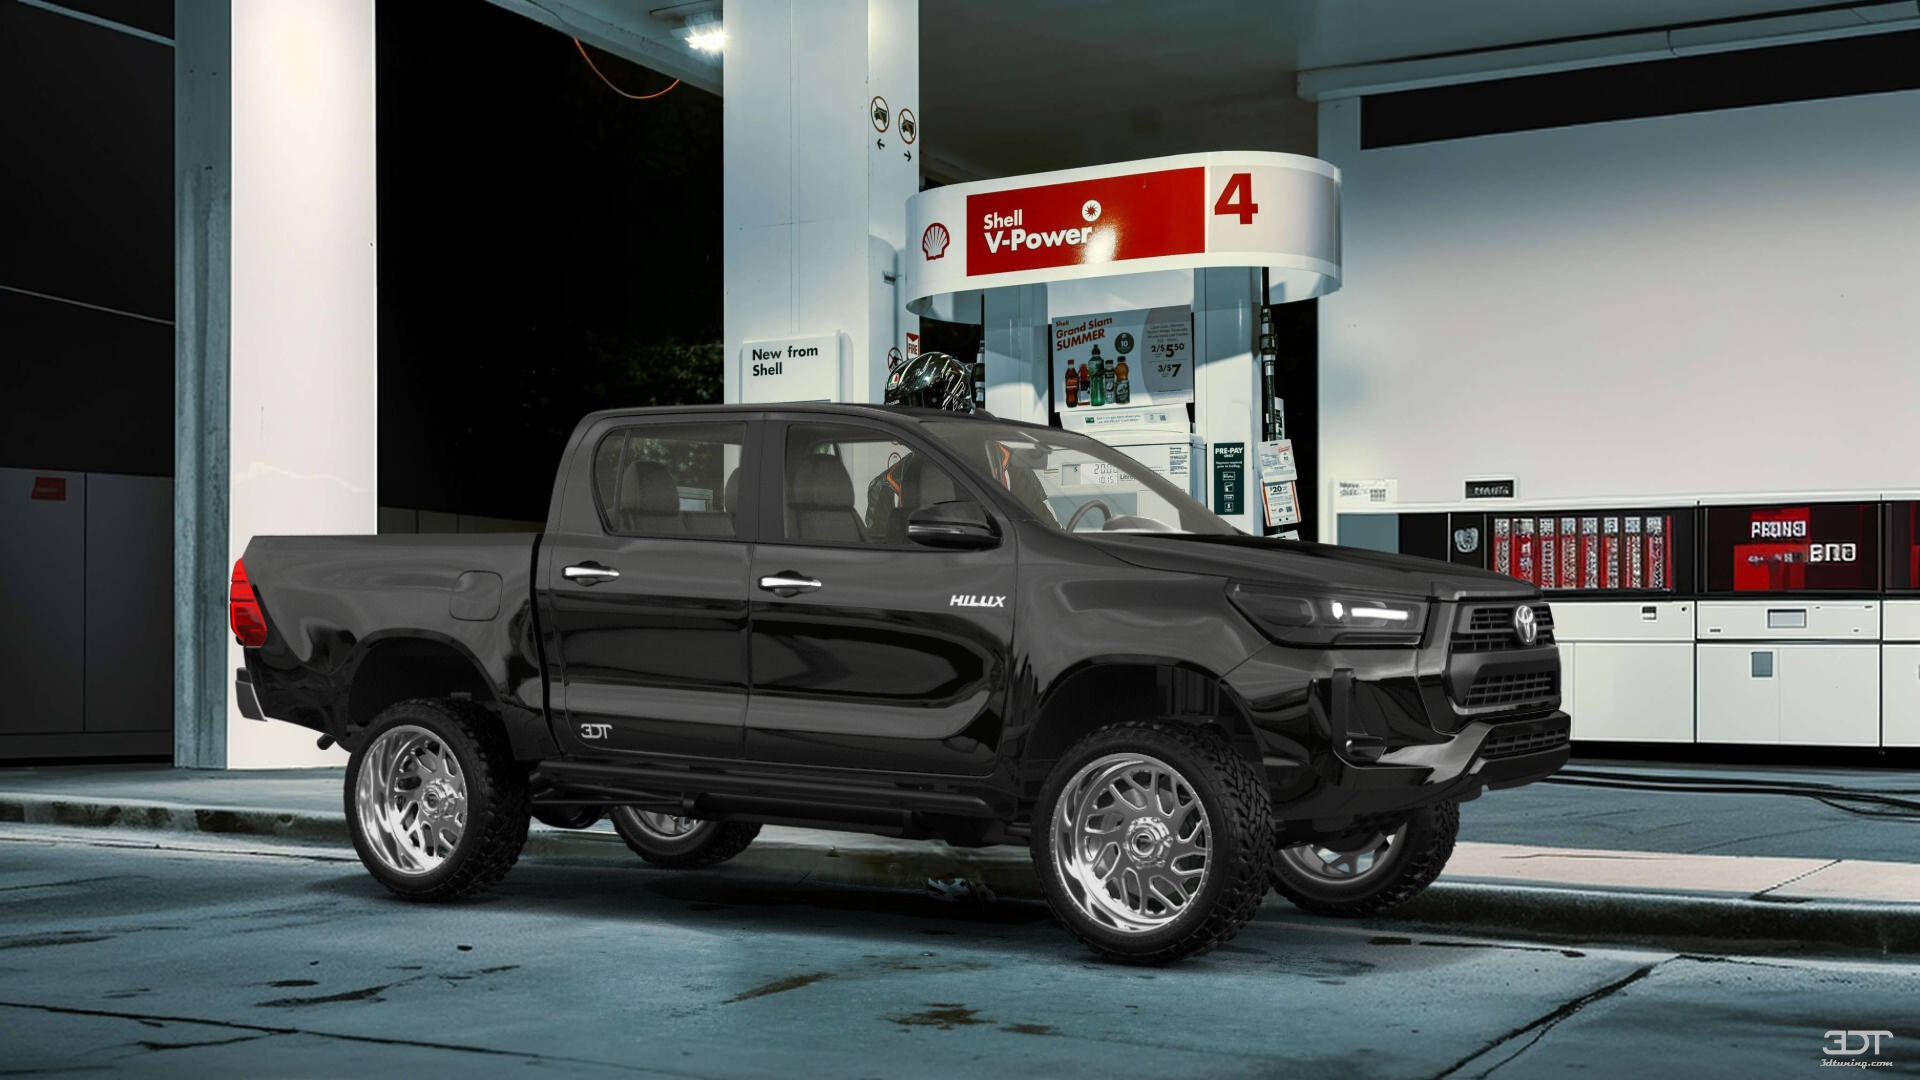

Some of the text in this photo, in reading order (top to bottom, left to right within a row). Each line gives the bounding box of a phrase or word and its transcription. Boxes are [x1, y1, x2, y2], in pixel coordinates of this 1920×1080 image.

[1213, 172, 1258, 225] 4
[983, 209, 1023, 230] Shell
[983, 227, 1093, 254] V-Power
[1056, 317, 1113, 339] Grand Slam
[1056, 329, 1105, 351] SUMMER
[752, 345, 818, 361] New from
[752, 363, 783, 376] Shell
[1215, 447, 1243, 455] PRE-PAY
[949, 594, 1006, 608] HILUX
[581, 723, 613, 739] 3DT
